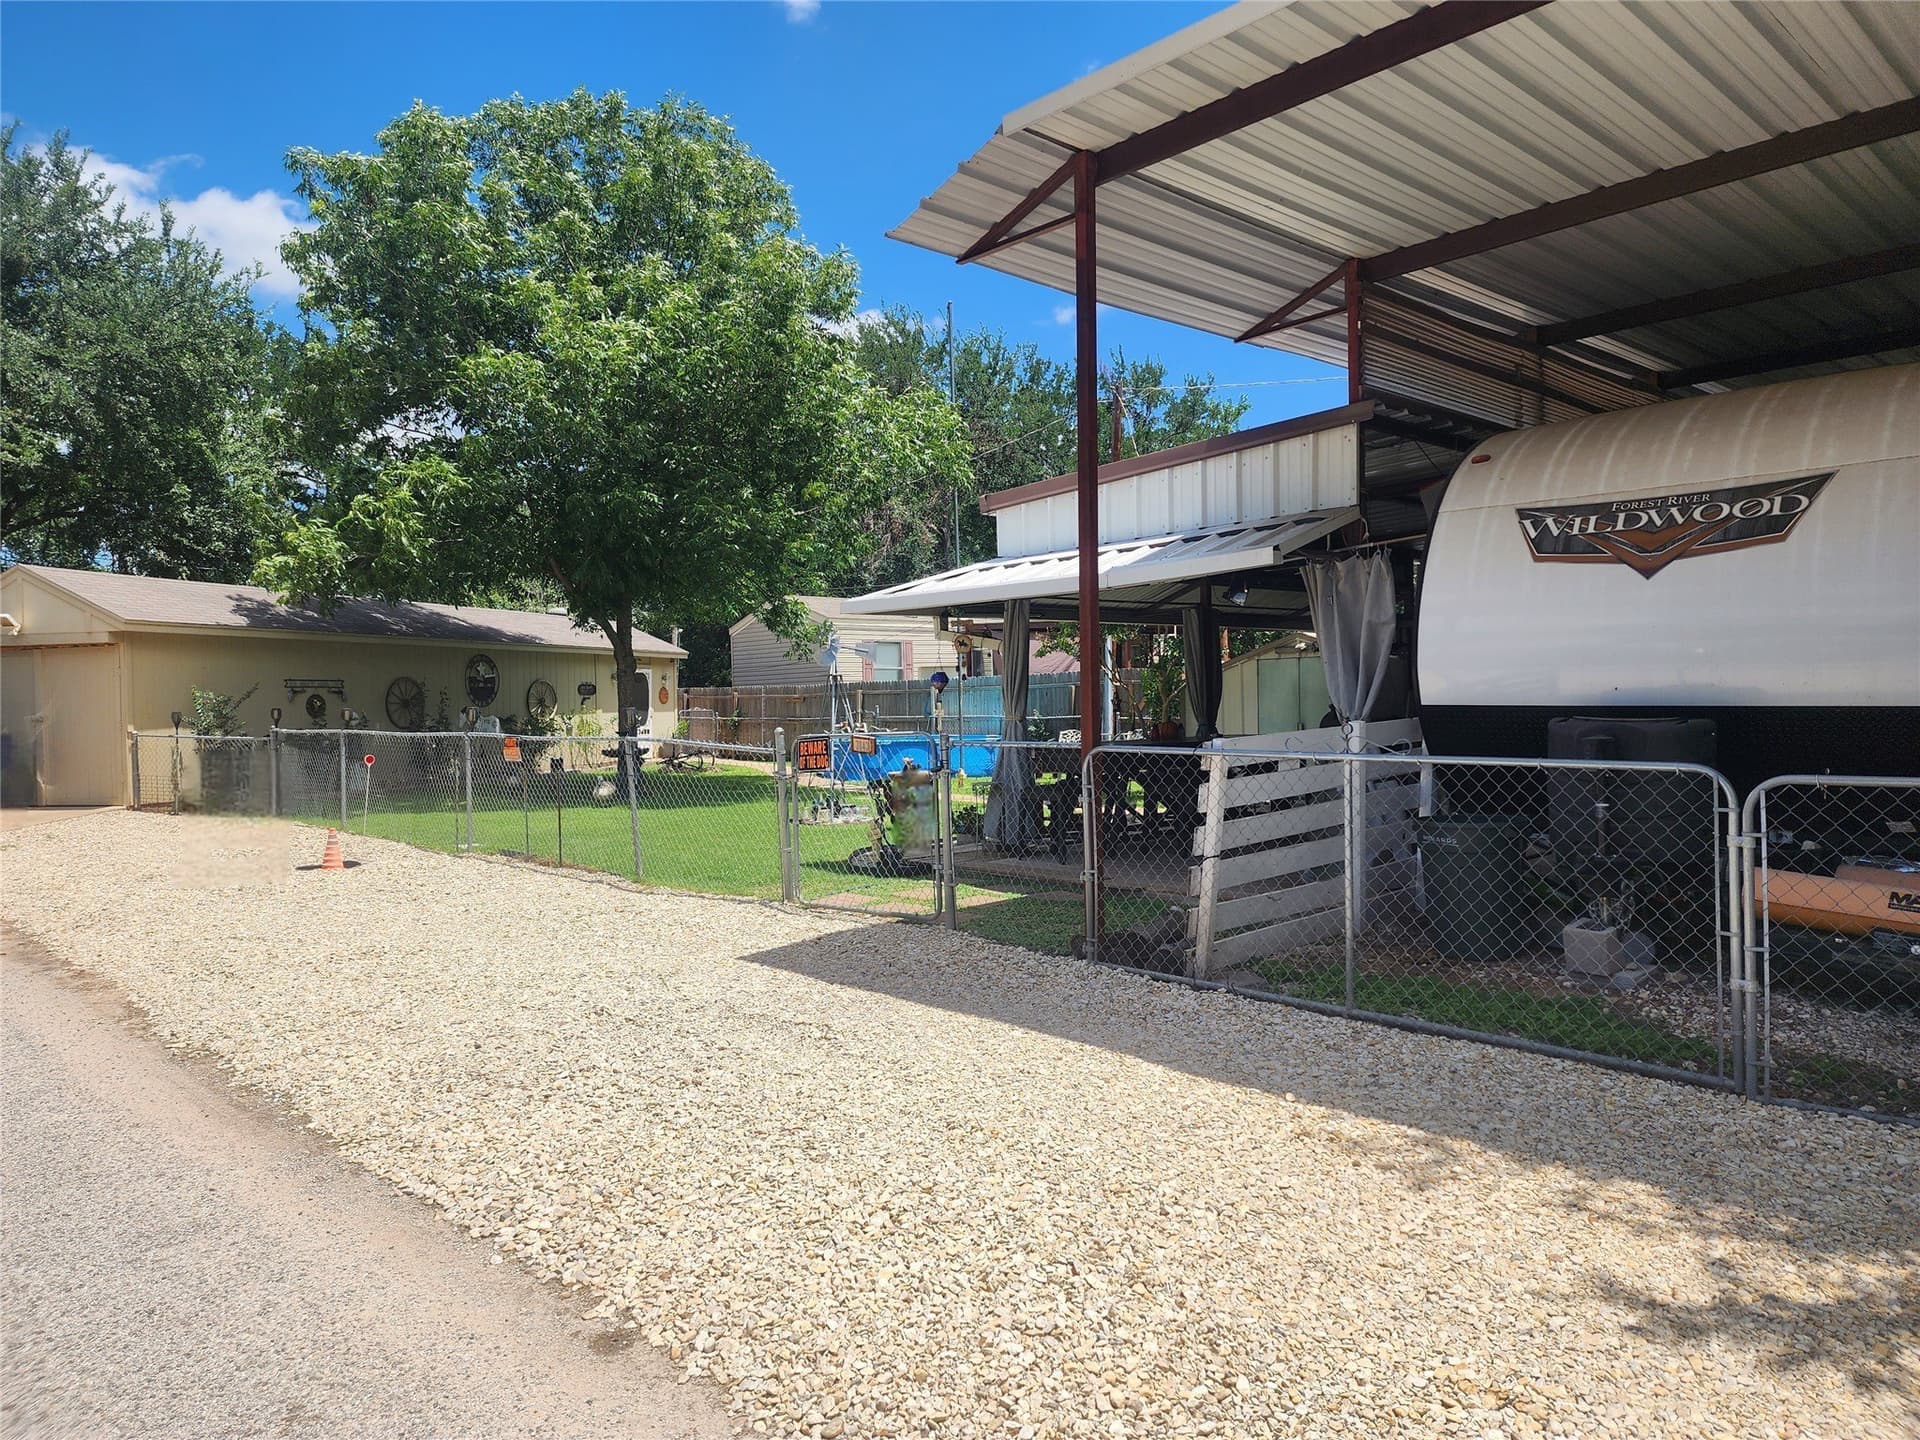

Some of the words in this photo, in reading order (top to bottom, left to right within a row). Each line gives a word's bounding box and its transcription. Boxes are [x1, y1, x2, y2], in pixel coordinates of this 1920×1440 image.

[1611, 499, 1664, 513] FOREST
[1667, 493, 1711, 506] RIVER
[1519, 494, 1810, 540] WILDWOOD
[800, 740, 827, 756] BEWARE
[800, 756, 806, 769] OF
[807, 755, 817, 769] THE
[817, 754, 829, 768] DOG
